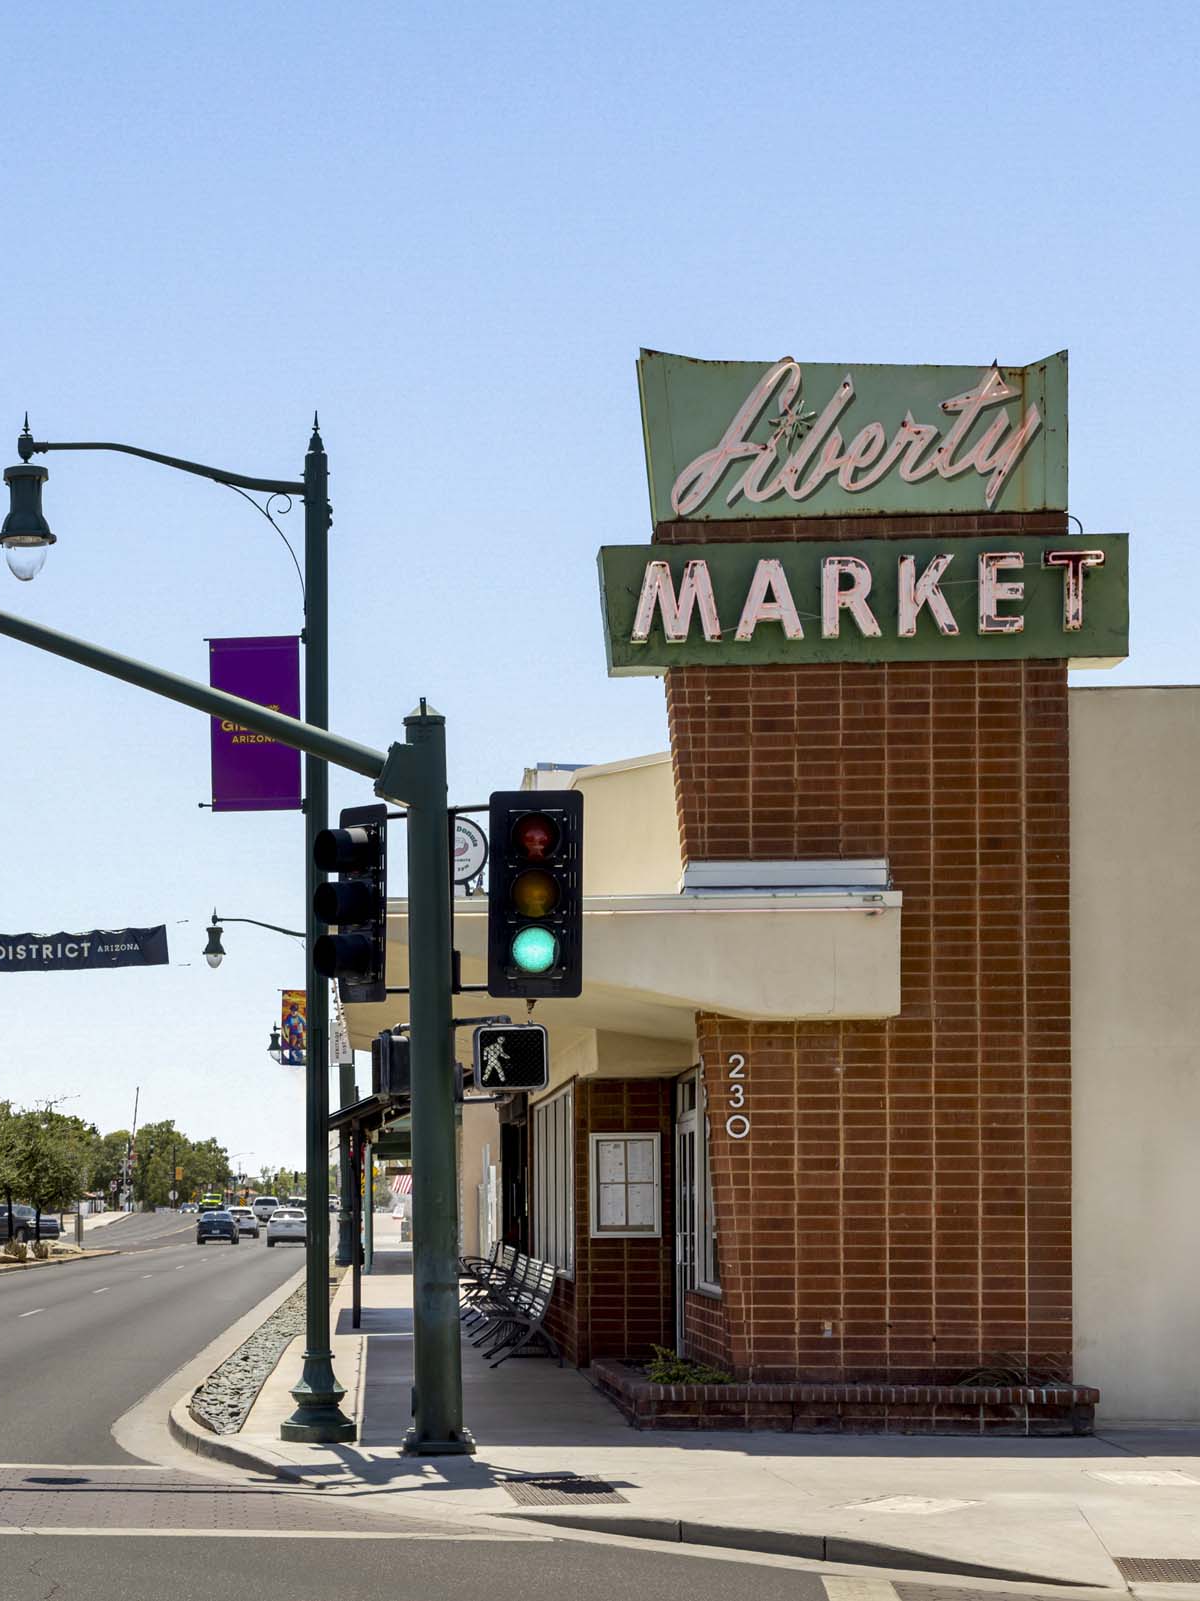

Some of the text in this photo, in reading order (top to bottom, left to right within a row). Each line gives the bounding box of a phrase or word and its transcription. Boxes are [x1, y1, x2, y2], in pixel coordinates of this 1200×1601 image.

[671, 357, 1042, 516] Liberty
[630, 550, 1106, 644] MARKET
[97, 943, 140, 953] ARIZONA
[726, 1053, 750, 1139] 230
